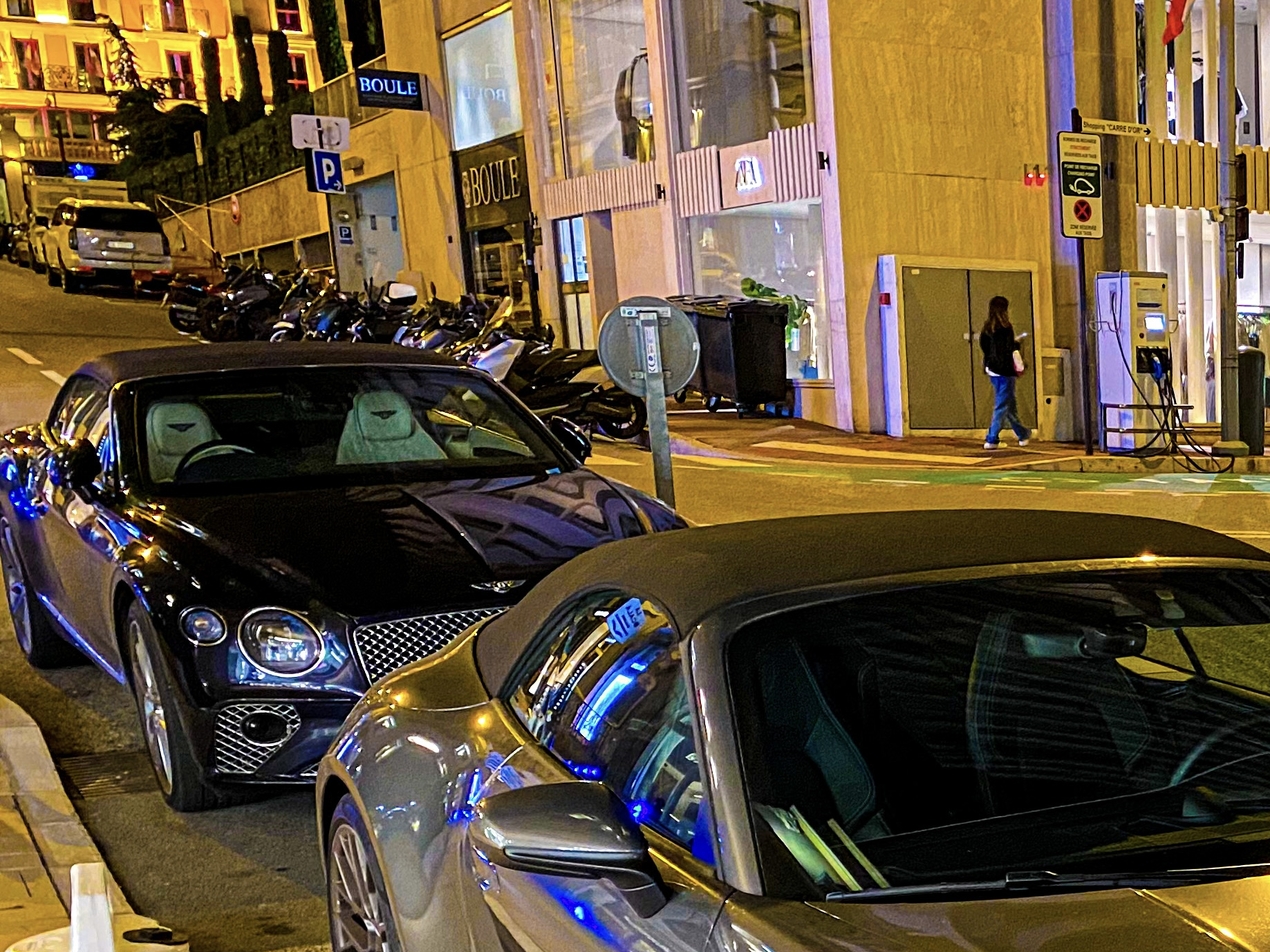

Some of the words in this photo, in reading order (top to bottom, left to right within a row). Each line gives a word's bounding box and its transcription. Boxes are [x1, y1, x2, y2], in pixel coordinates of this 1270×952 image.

[359, 77, 418, 96] BOULE
[1083, 121, 1105, 131] Shopping
[322, 158, 335, 184] P
[470, 156, 521, 206] BOULE
[341, 227, 349, 238] P
